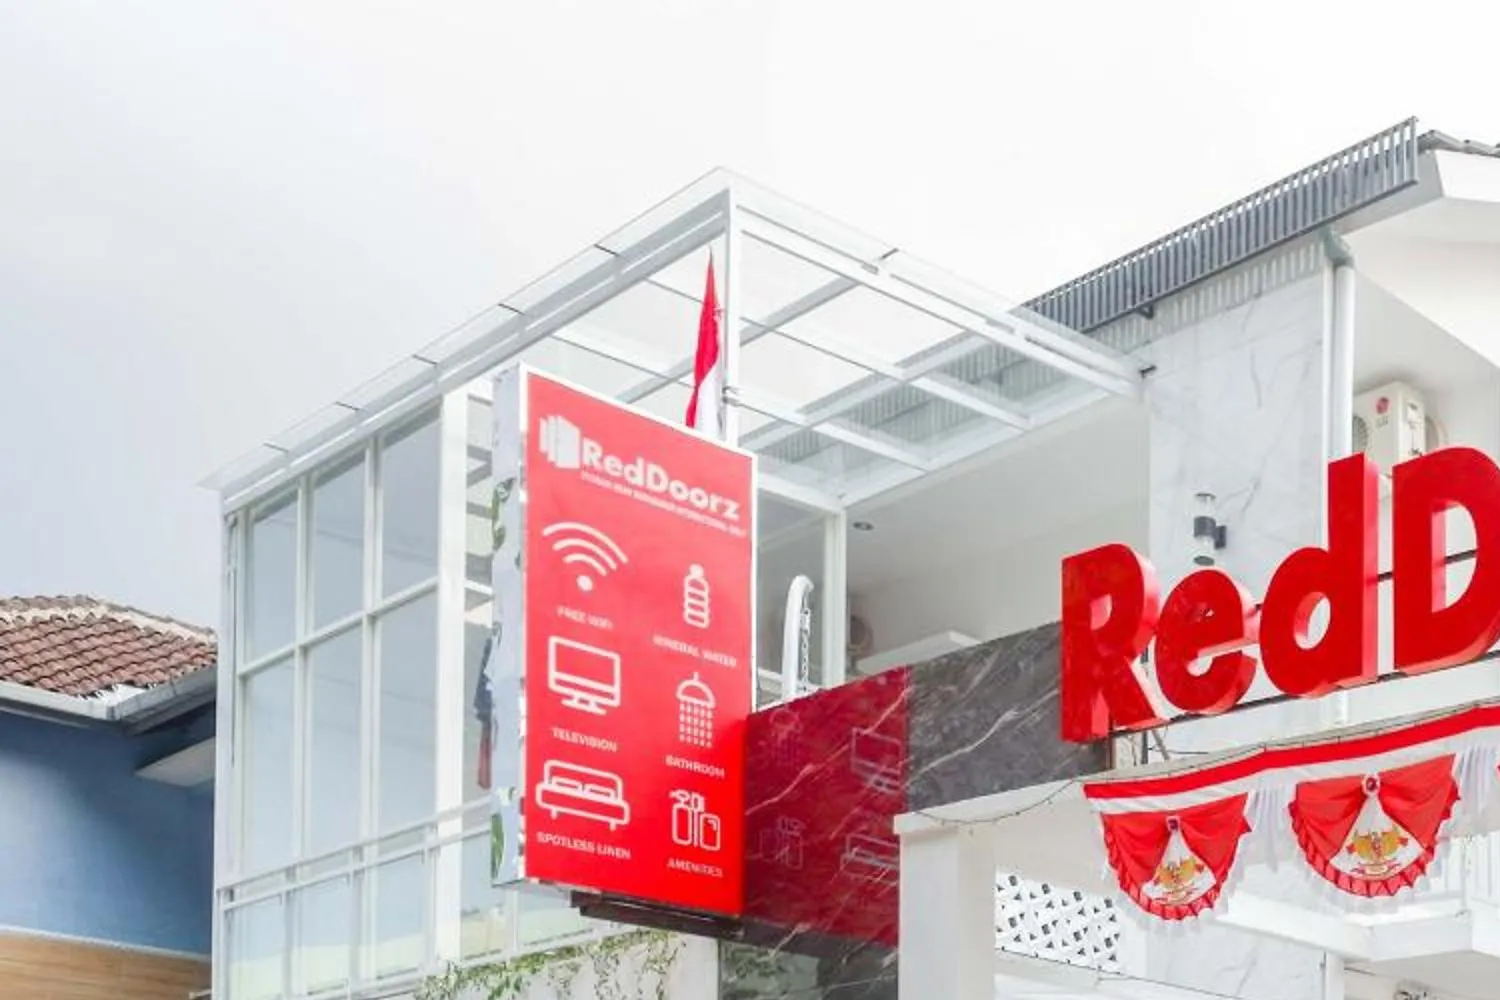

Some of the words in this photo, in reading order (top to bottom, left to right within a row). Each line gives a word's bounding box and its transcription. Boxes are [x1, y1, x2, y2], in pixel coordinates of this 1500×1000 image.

[582, 437, 741, 521] RedDoorz
[702, 649, 737, 667] WATER
[553, 727, 617, 752] TELEVISION
[665, 754, 725, 778] BATHROOM
[537, 831, 595, 853] SPOTLESS
[597, 843, 632, 859] LINEN
